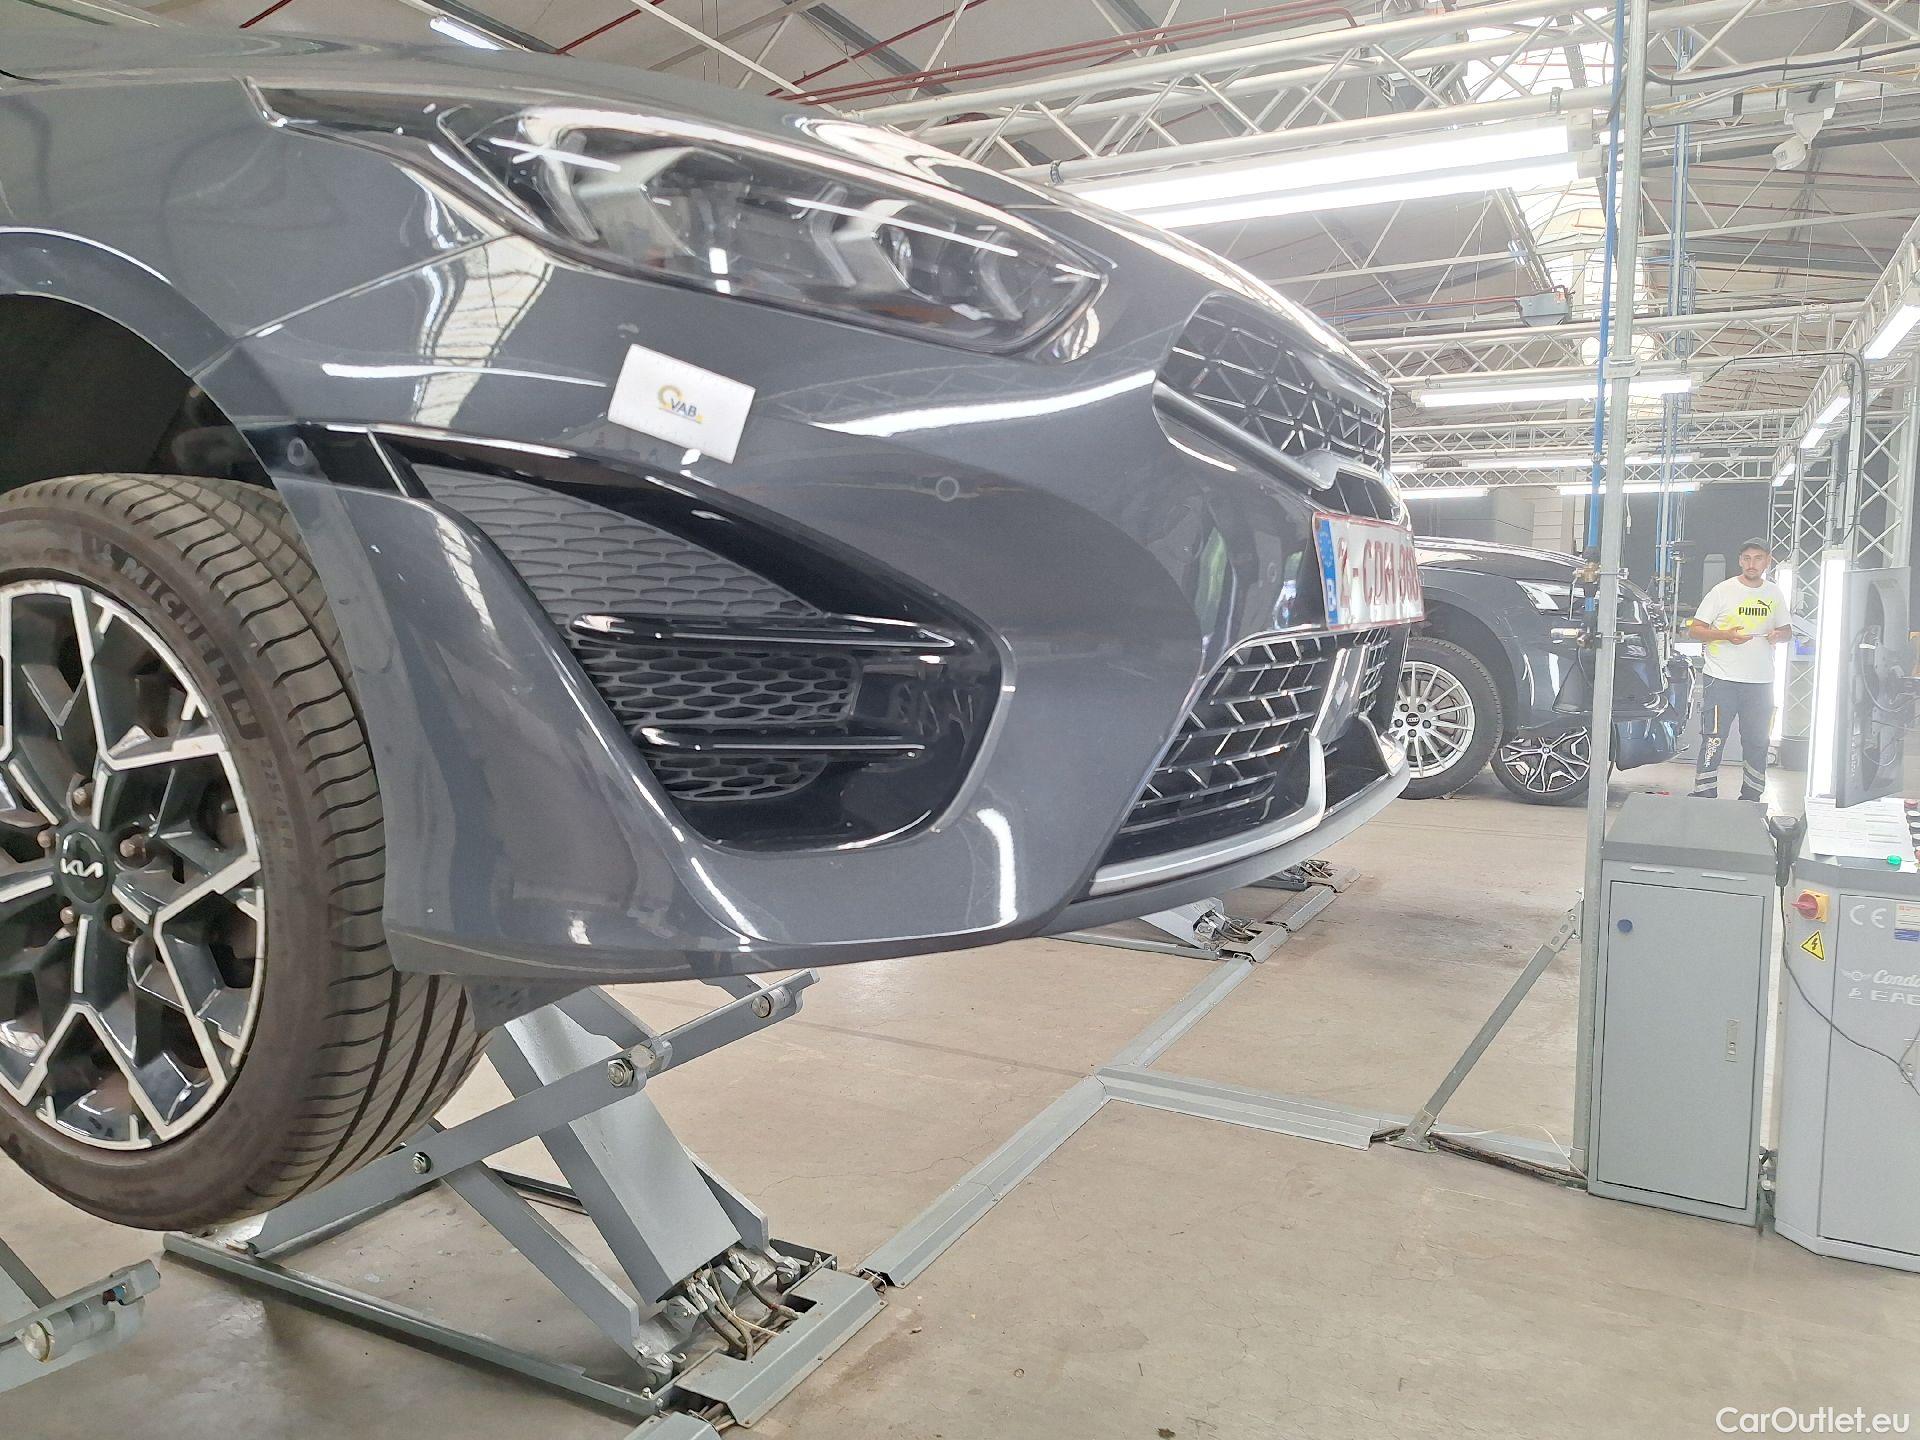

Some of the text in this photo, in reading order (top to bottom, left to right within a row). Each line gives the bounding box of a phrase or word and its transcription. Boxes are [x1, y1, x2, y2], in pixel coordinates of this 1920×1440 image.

[671, 397, 697, 418] VAB
[1738, 606, 1768, 617] PUMA
[120, 555, 260, 728] MICHELIN
